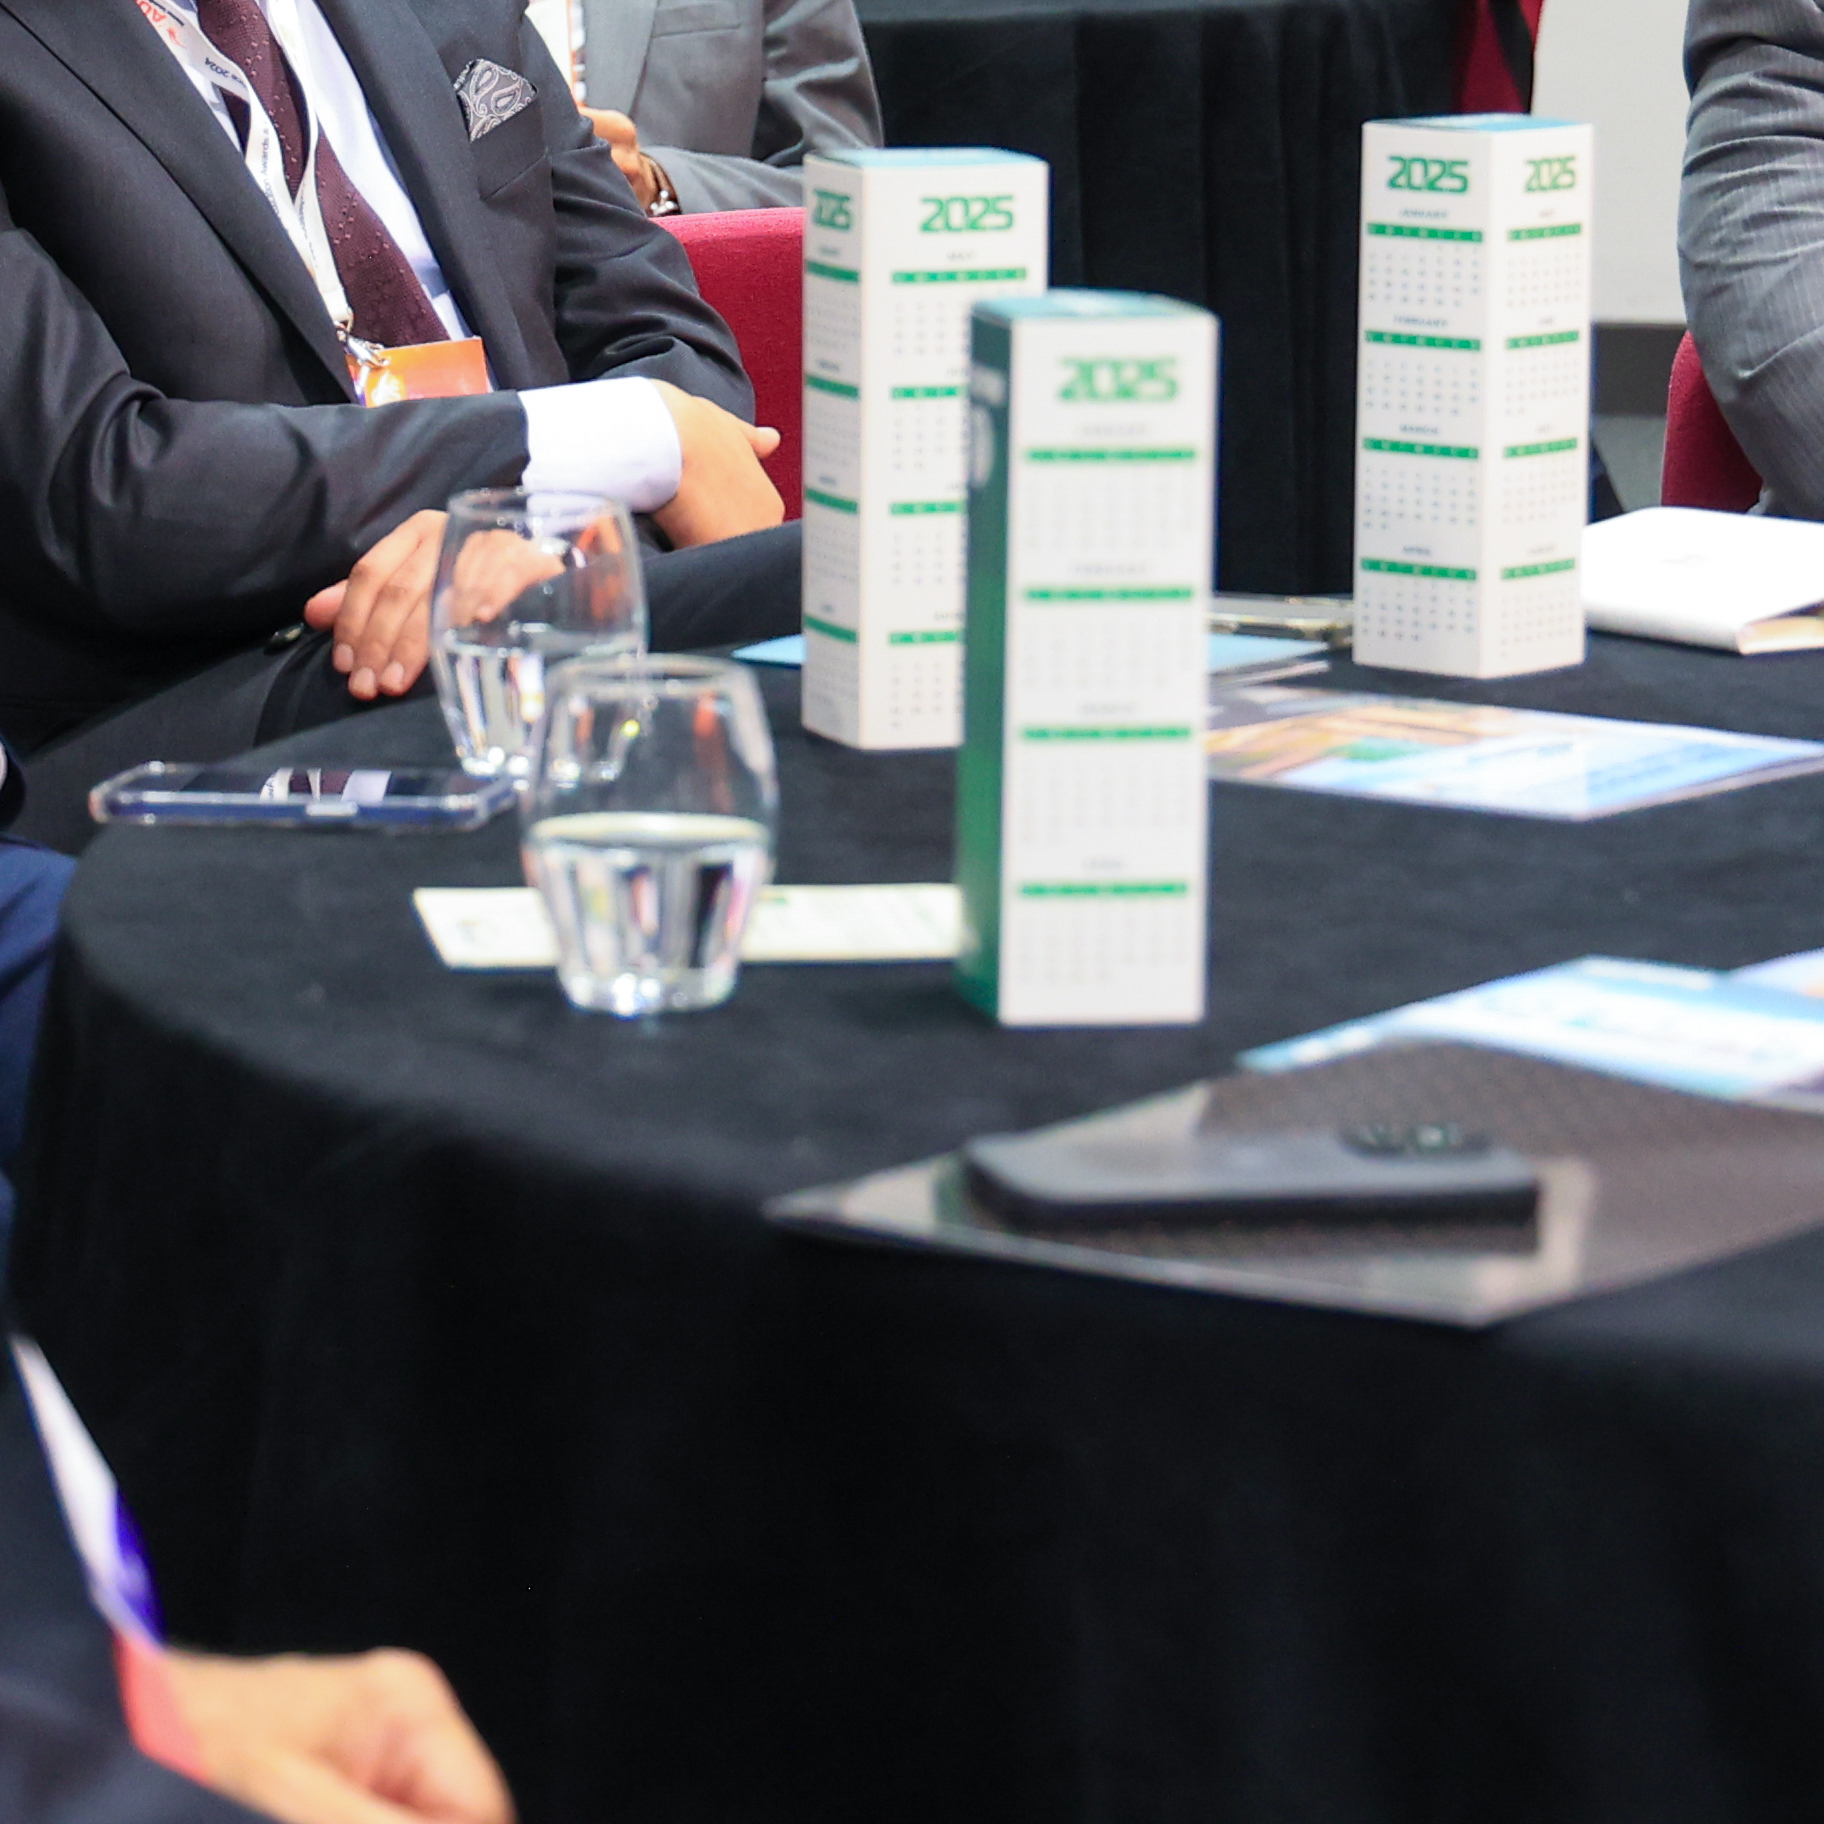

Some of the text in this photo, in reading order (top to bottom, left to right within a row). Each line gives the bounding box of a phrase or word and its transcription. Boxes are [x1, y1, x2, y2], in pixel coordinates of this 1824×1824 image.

[202, 56, 230, 79] 2024
[260, 137, 269, 175] Awards
[1386, 155, 1469, 194] 2025
[1523, 155, 1576, 194] 2025
[919, 195, 1015, 233] 2025
[1058, 356, 1180, 403] 2025
